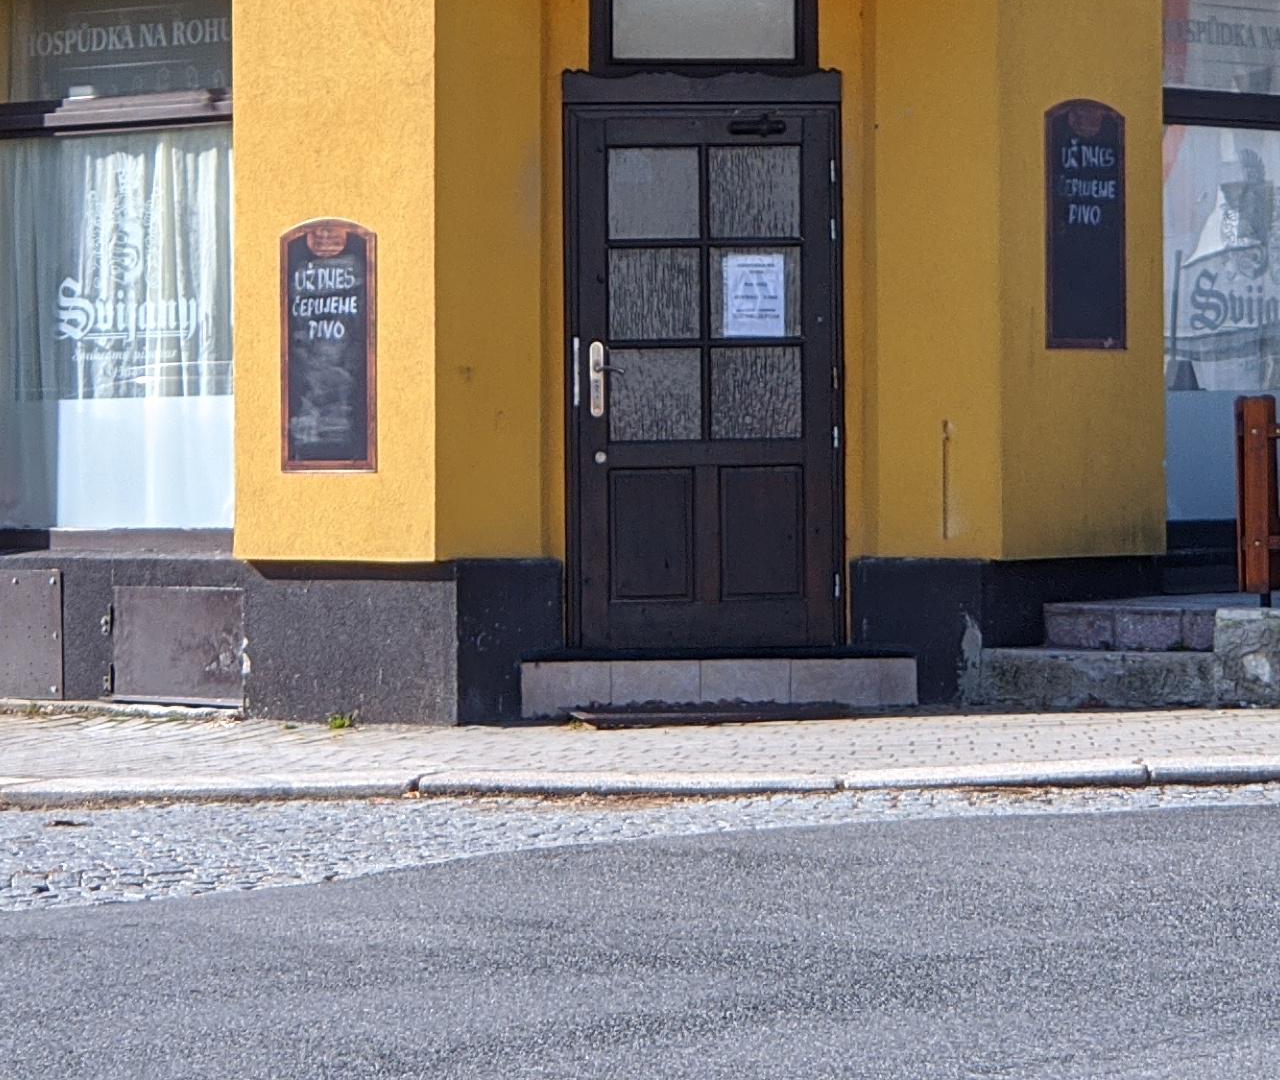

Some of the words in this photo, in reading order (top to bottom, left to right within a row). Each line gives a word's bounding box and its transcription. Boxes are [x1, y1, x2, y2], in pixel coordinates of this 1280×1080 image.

[139, 22, 168, 49] NA
[1068, 203, 1102, 226] PIVO
[294, 262, 316, 291] UŽ
[317, 267, 356, 291] DNES
[57, 277, 198, 341] Svijany
[308, 319, 346, 339] PIVO
